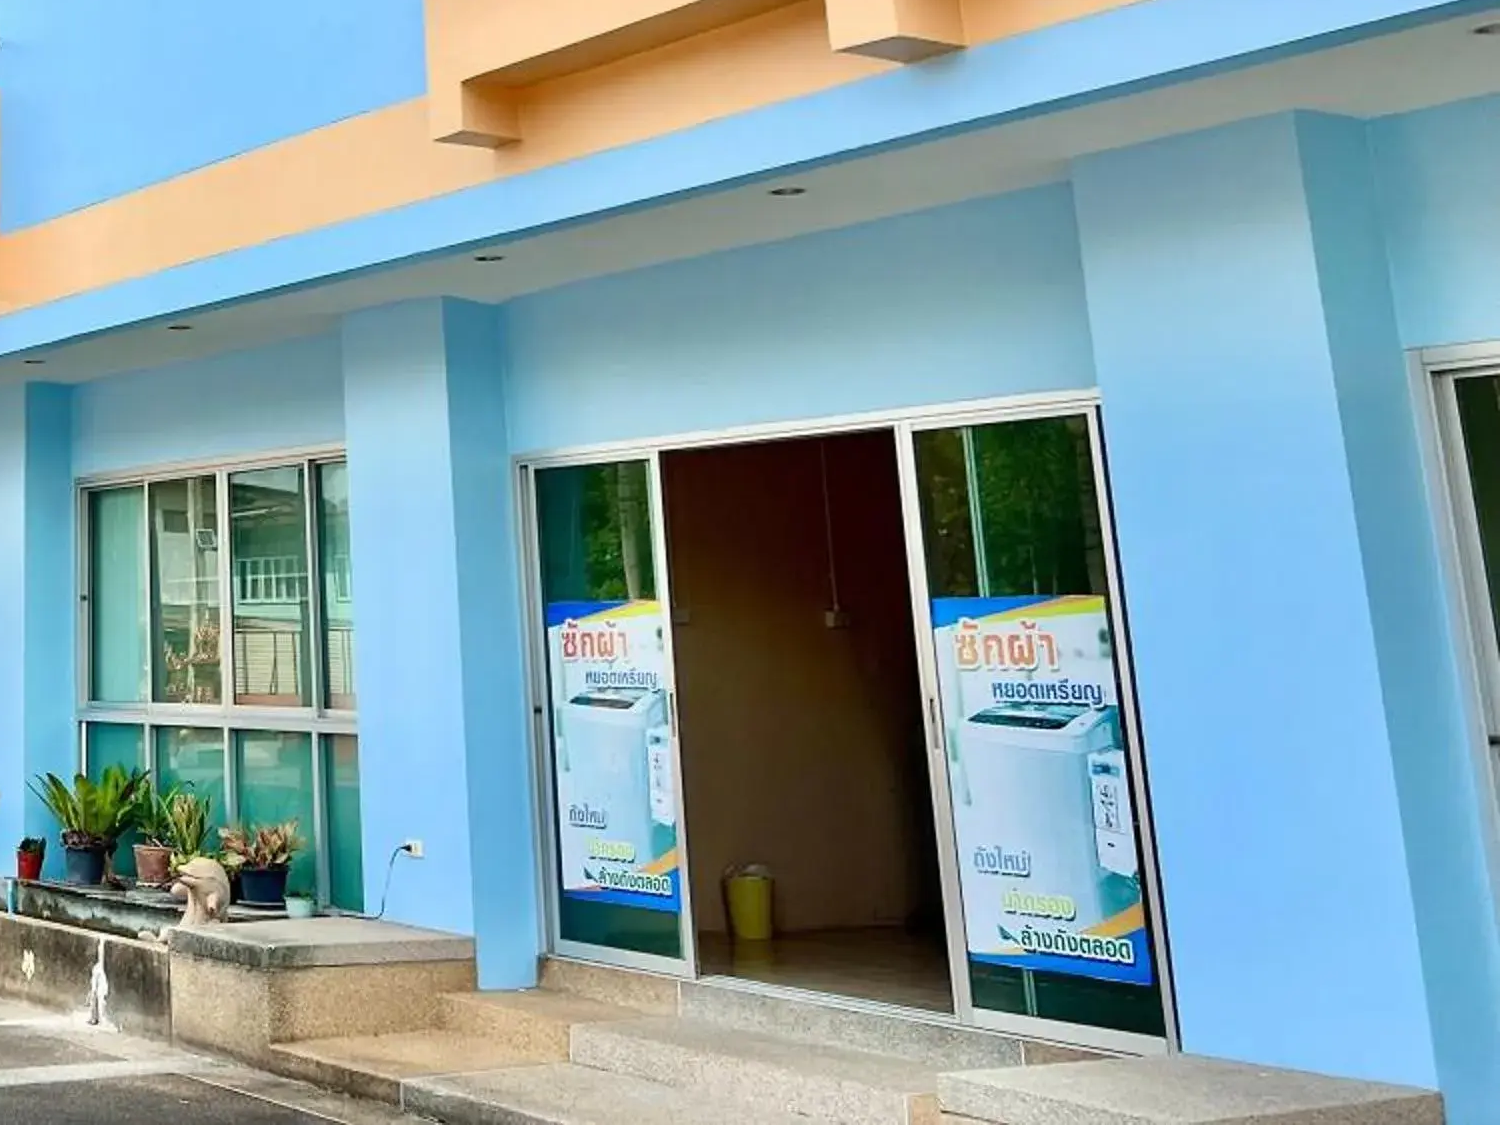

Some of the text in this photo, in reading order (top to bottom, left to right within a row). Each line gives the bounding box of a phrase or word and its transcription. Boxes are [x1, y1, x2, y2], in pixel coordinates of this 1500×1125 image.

[562, 620, 628, 658] ซักผ้า
[955, 620, 1057, 667] ซักผ้า
[991, 678, 1103, 705] หยอดเหรียญ
[1020, 924, 1132, 960] ล้างถังตลอด
